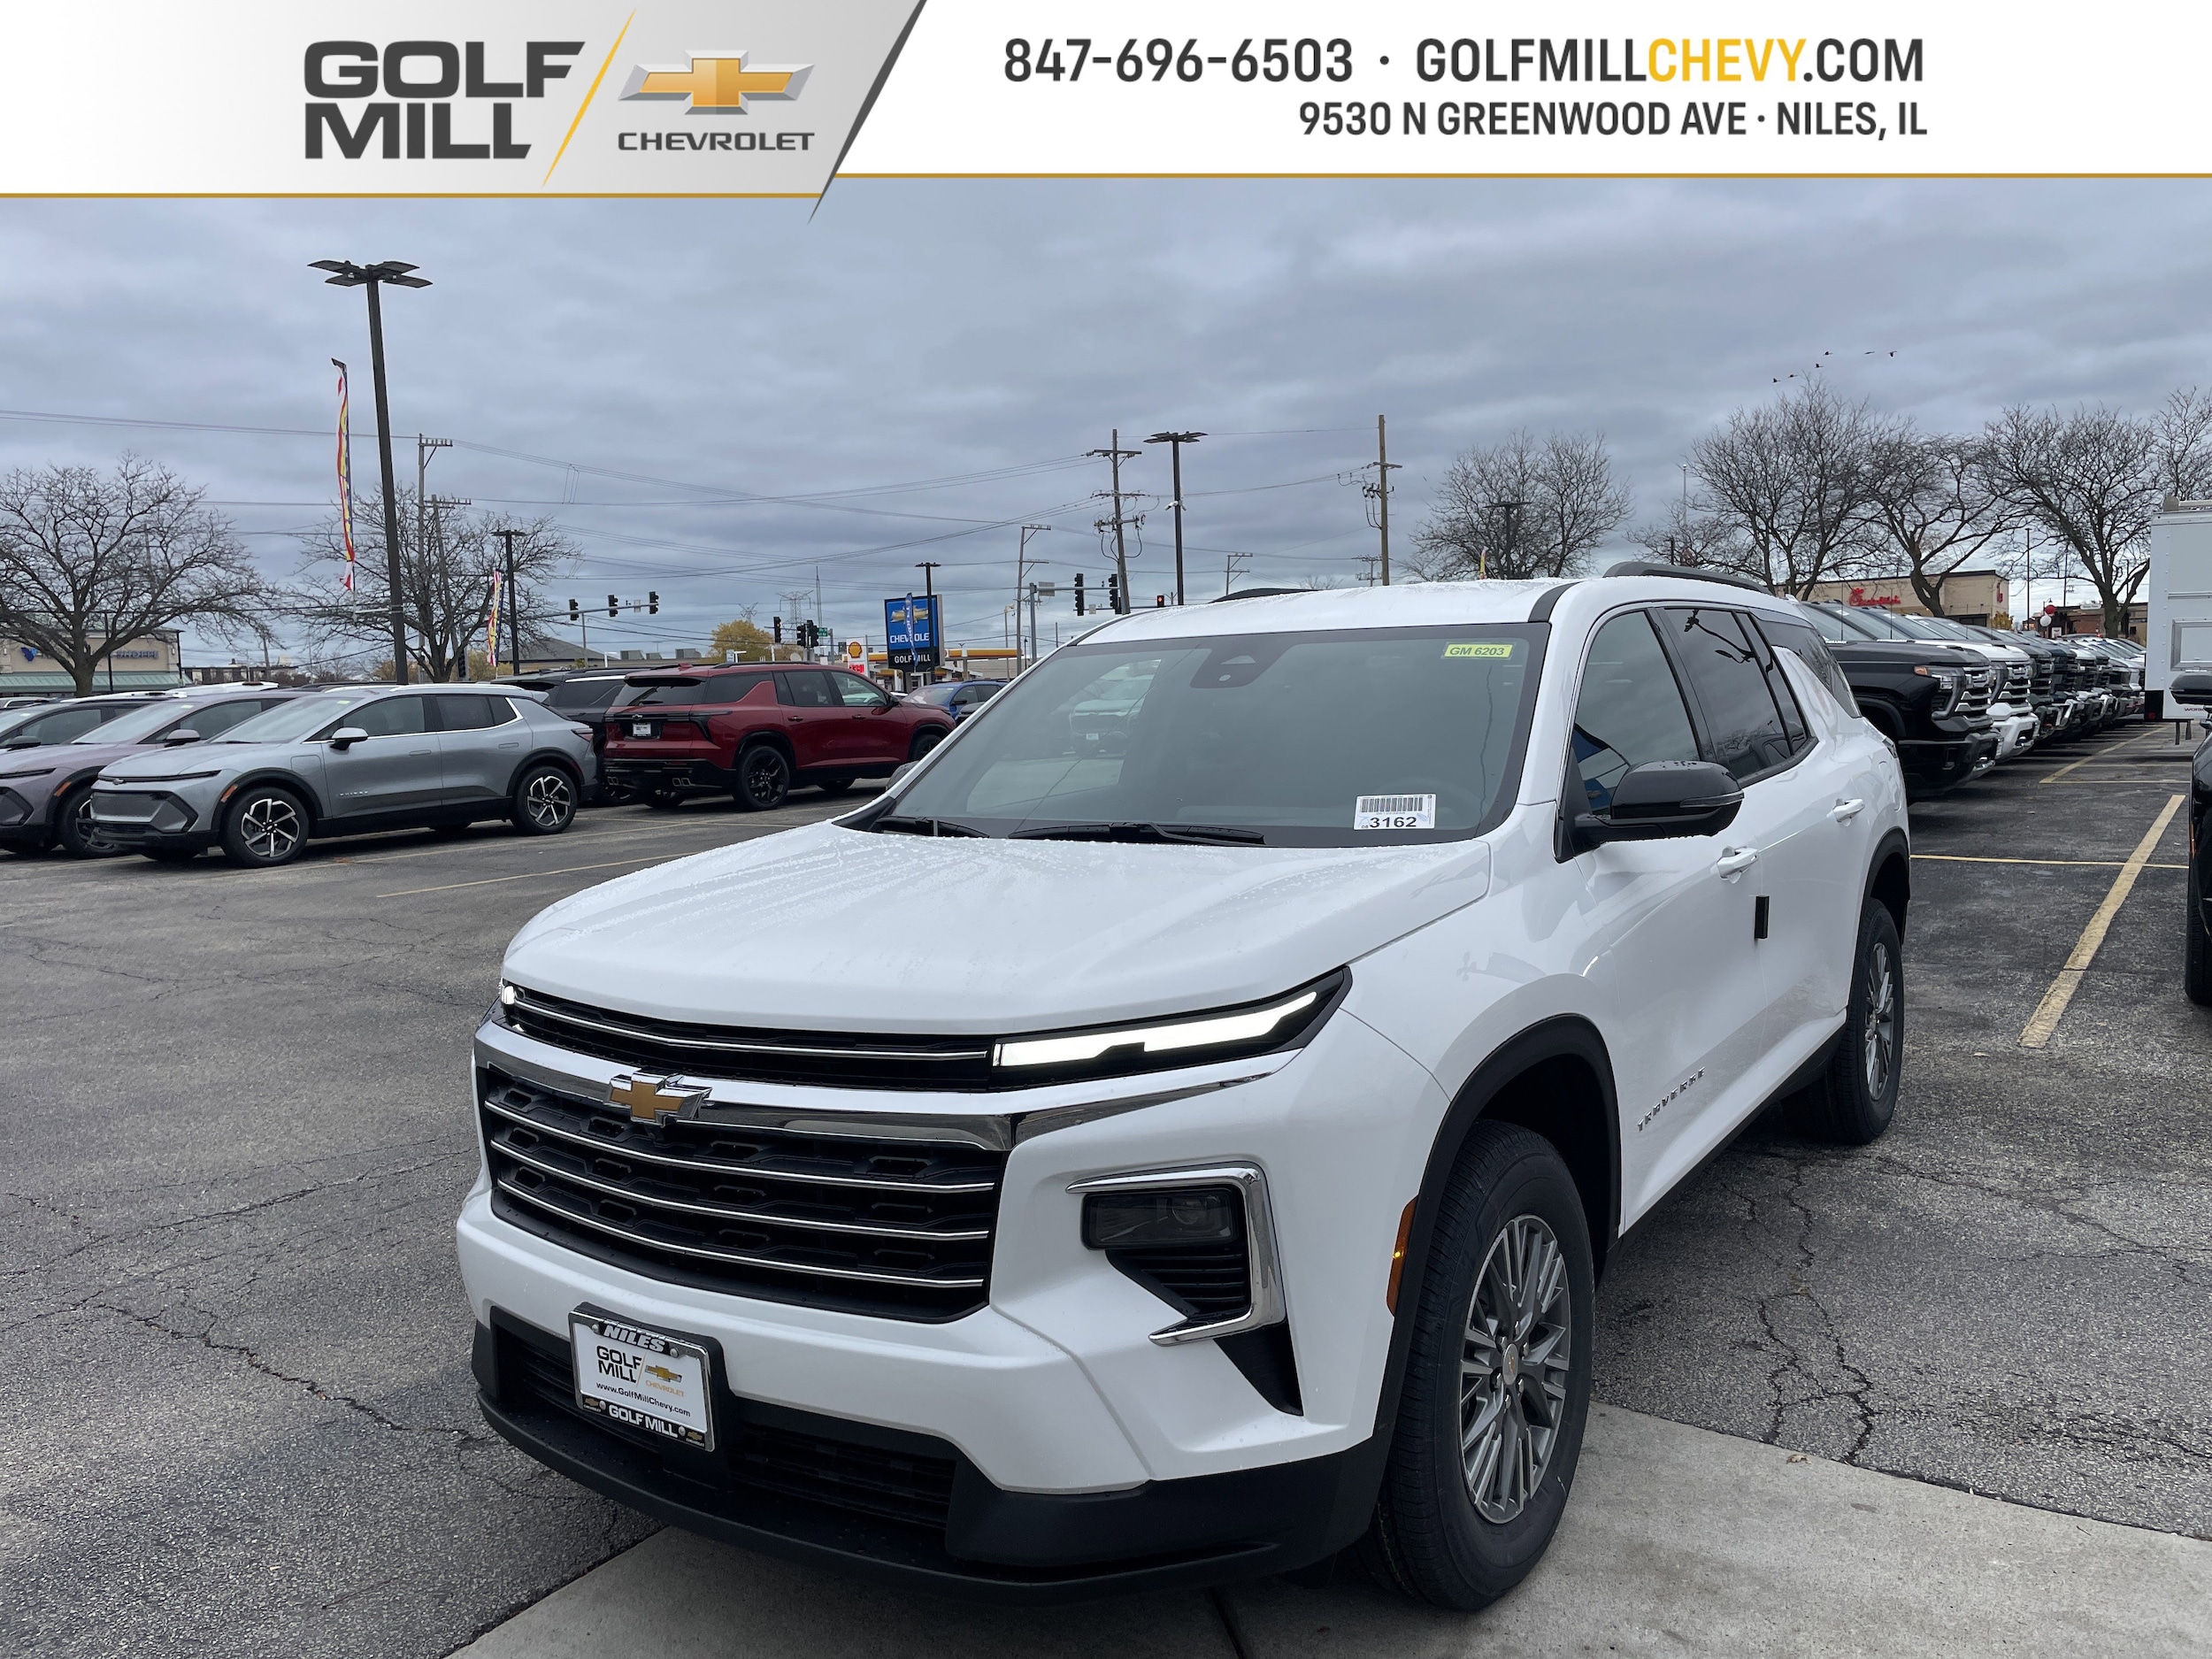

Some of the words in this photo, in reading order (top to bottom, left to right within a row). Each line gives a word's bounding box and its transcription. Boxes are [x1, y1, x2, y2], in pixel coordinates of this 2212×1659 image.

[895, 655, 912, 664] GOLF
[1449, 647, 1472, 656] GM
[1474, 647, 1505, 656] 6203
[1370, 817, 1417, 828] 3162
[603, 1324, 665, 1352] NILES
[596, 1345, 642, 1370] GOLF
[598, 1359, 637, 1384] MILL
[596, 1382, 691, 1417] www.GolfMillChevy.com
[608, 1404, 644, 1425] GOLF
[644, 1417, 679, 1439] MILL
